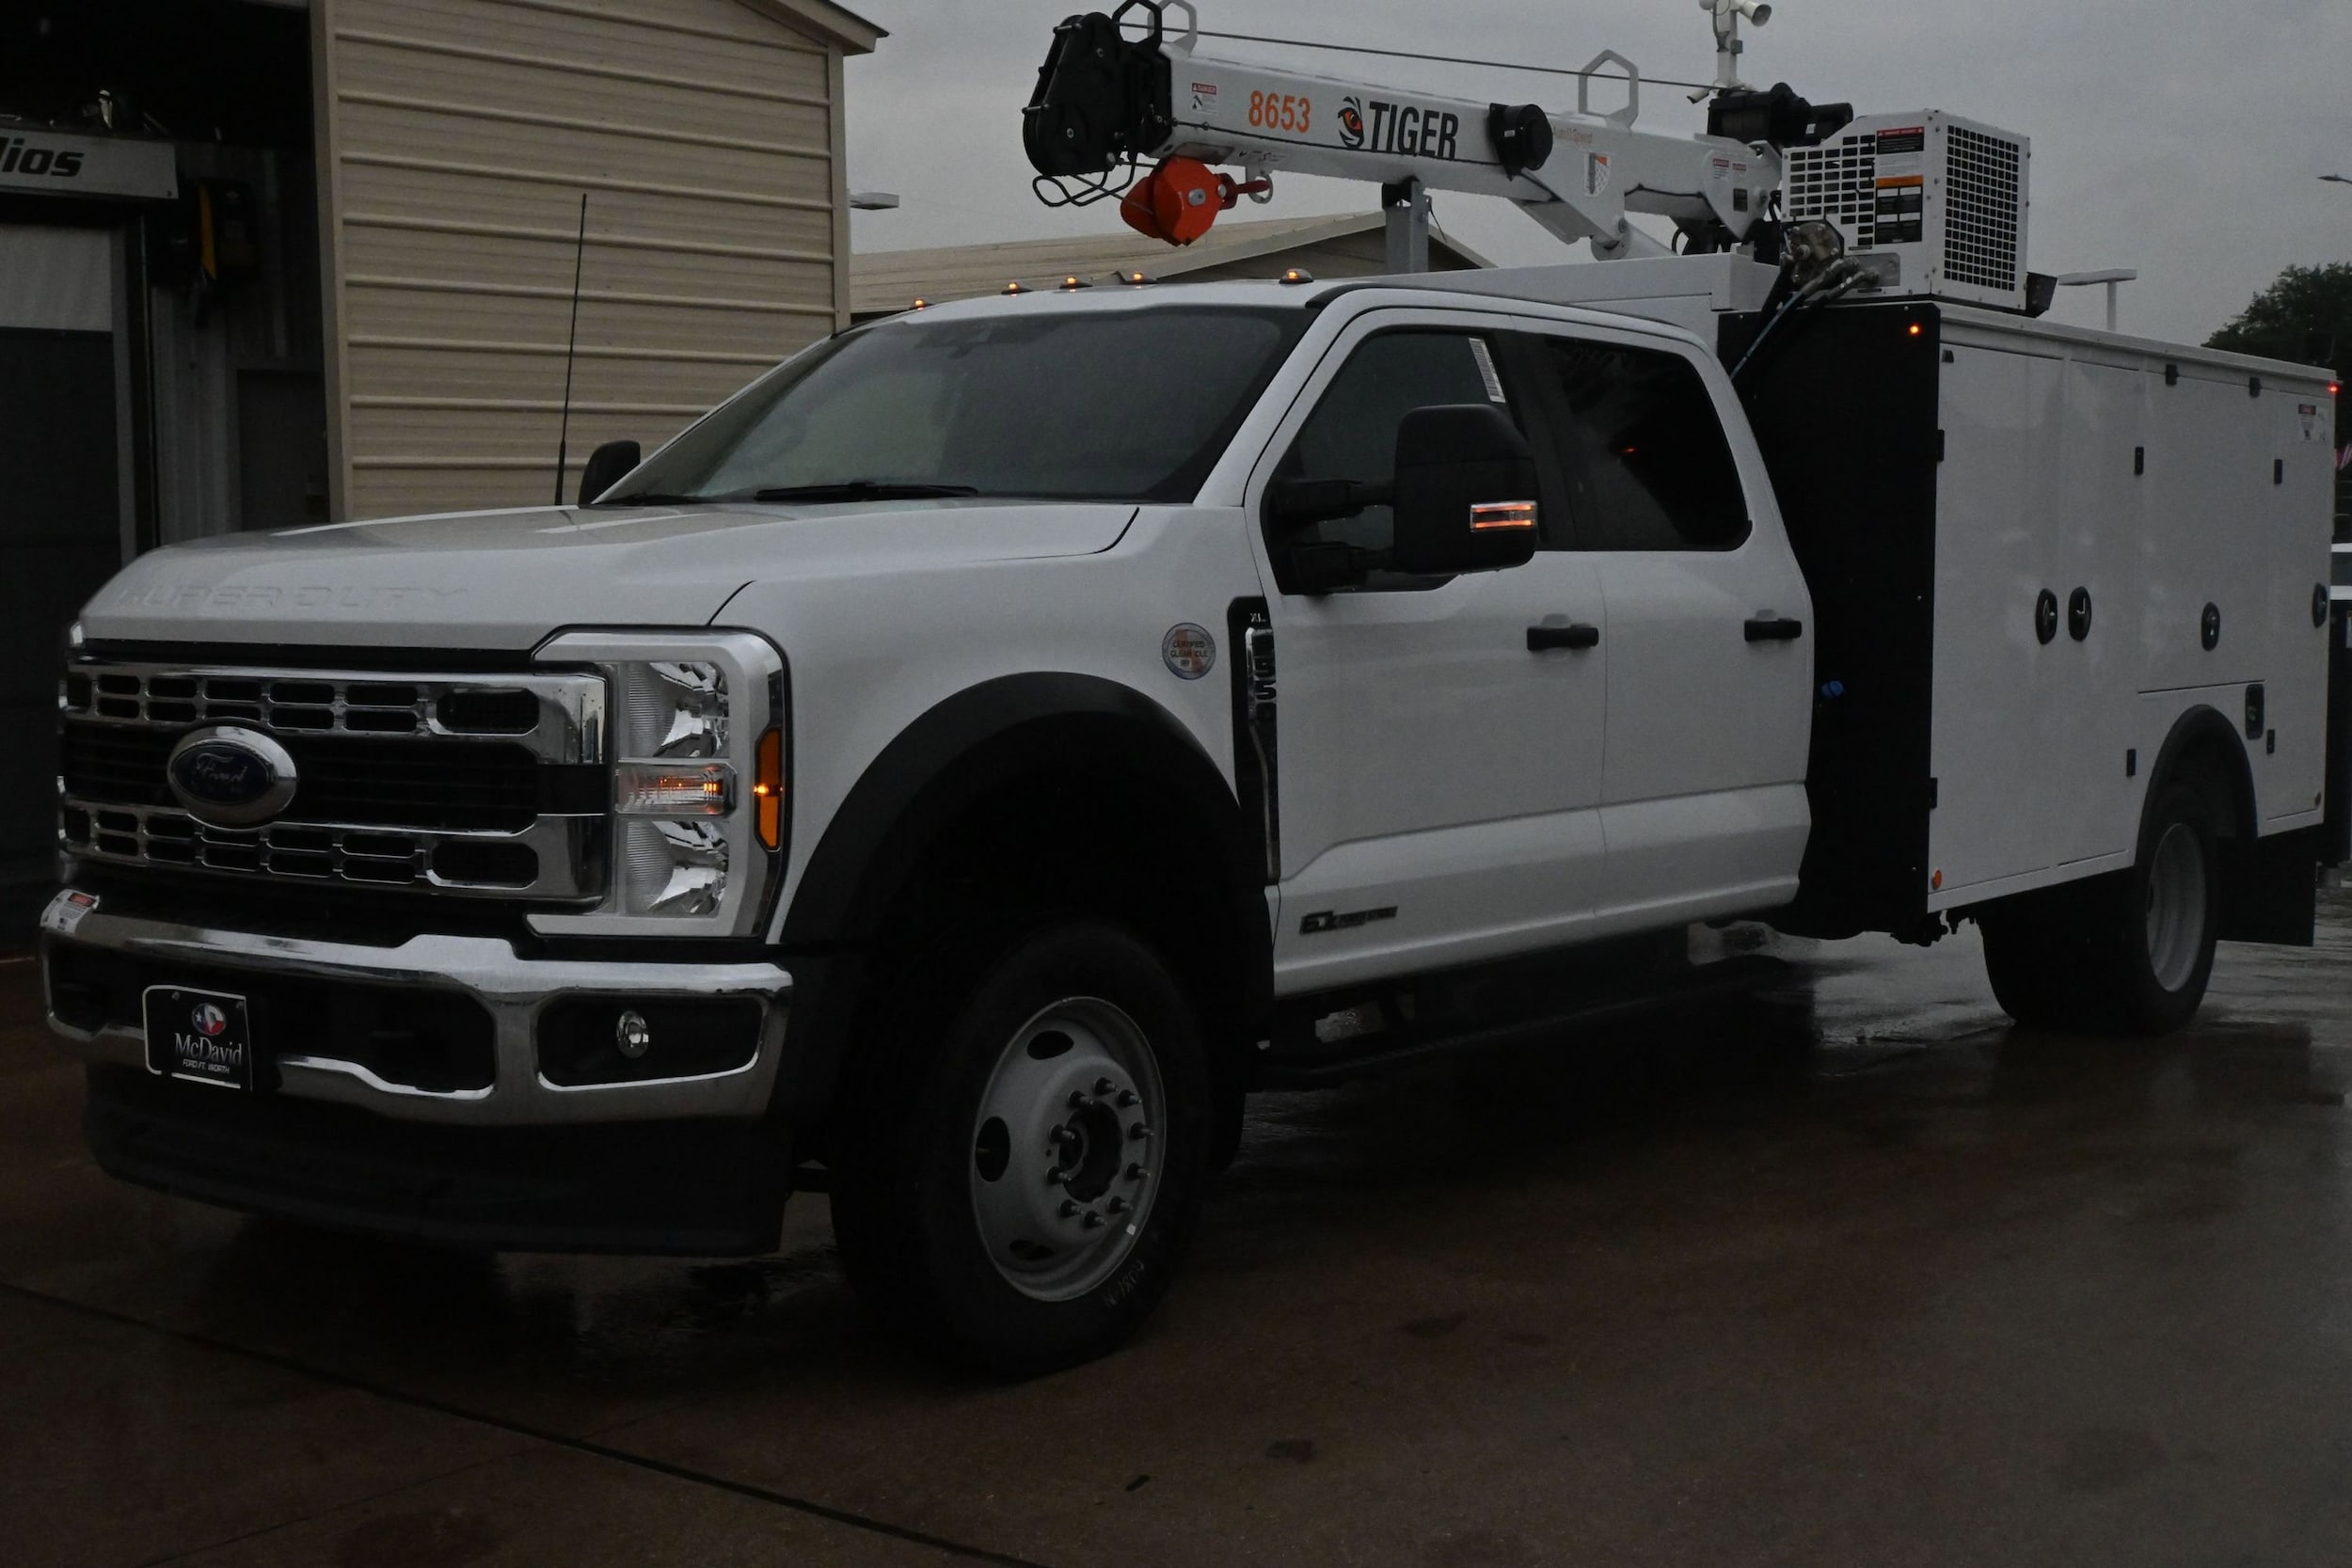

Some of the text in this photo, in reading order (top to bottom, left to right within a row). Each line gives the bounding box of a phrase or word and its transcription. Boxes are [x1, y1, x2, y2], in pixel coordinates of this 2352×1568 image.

[1248, 90, 1311, 133] 8653
[1369, 101, 1458, 161] TIGER
[196, 752, 248, 784] Ford
[174, 1033, 243, 1067] McDavid
[183, 1058, 199, 1069] FORD
[208, 1063, 230, 1074] WORTH
